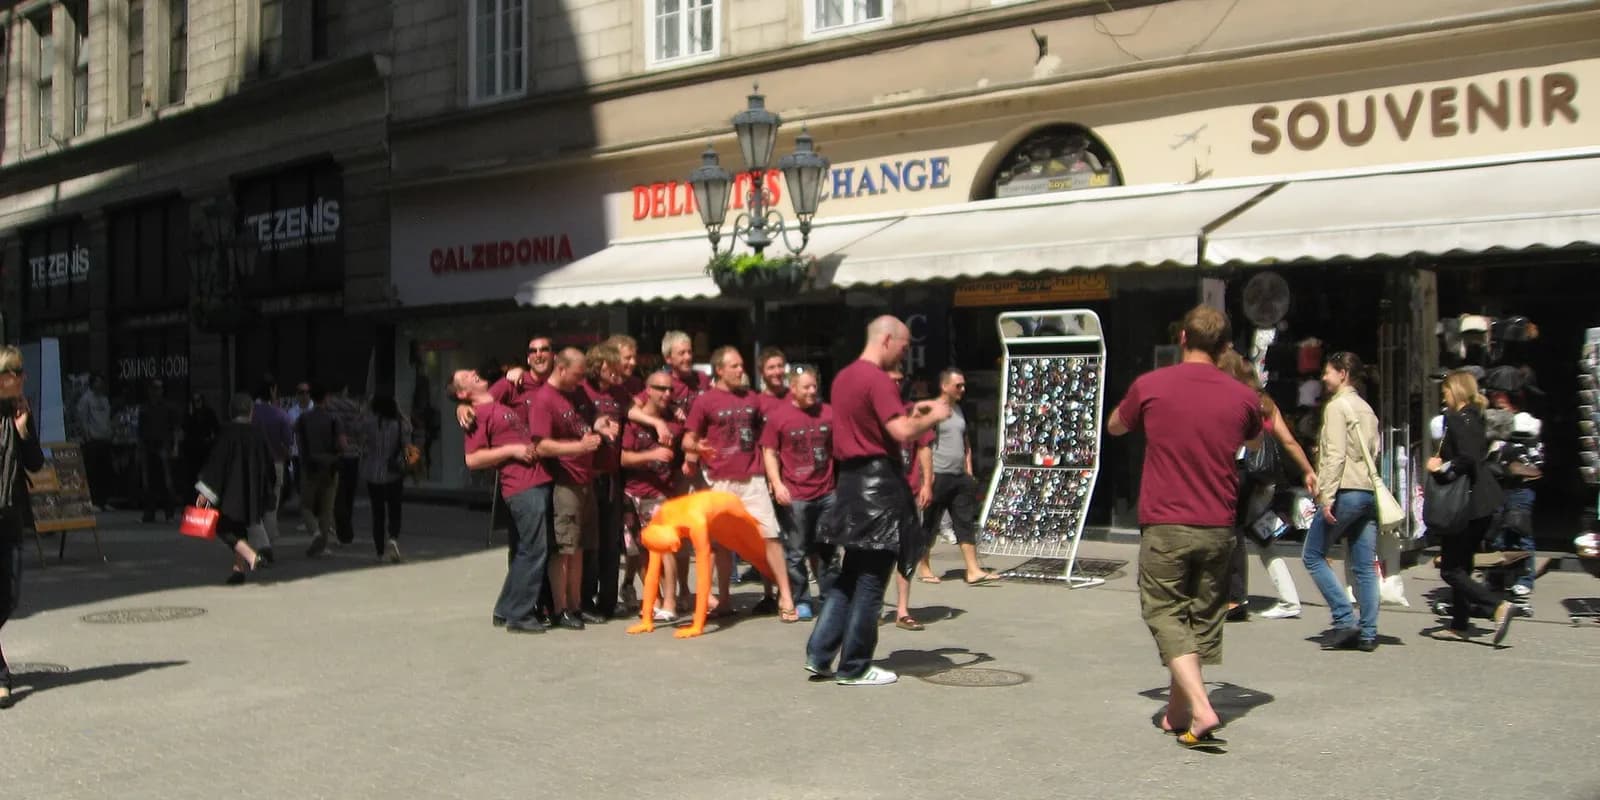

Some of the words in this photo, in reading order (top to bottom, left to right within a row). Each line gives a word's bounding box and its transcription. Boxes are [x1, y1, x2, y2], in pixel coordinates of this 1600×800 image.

[1250, 72, 1580, 155] SOUVENIR
[632, 168, 781, 221] DELITES
[429, 232, 574, 276] CALZEDONIA
